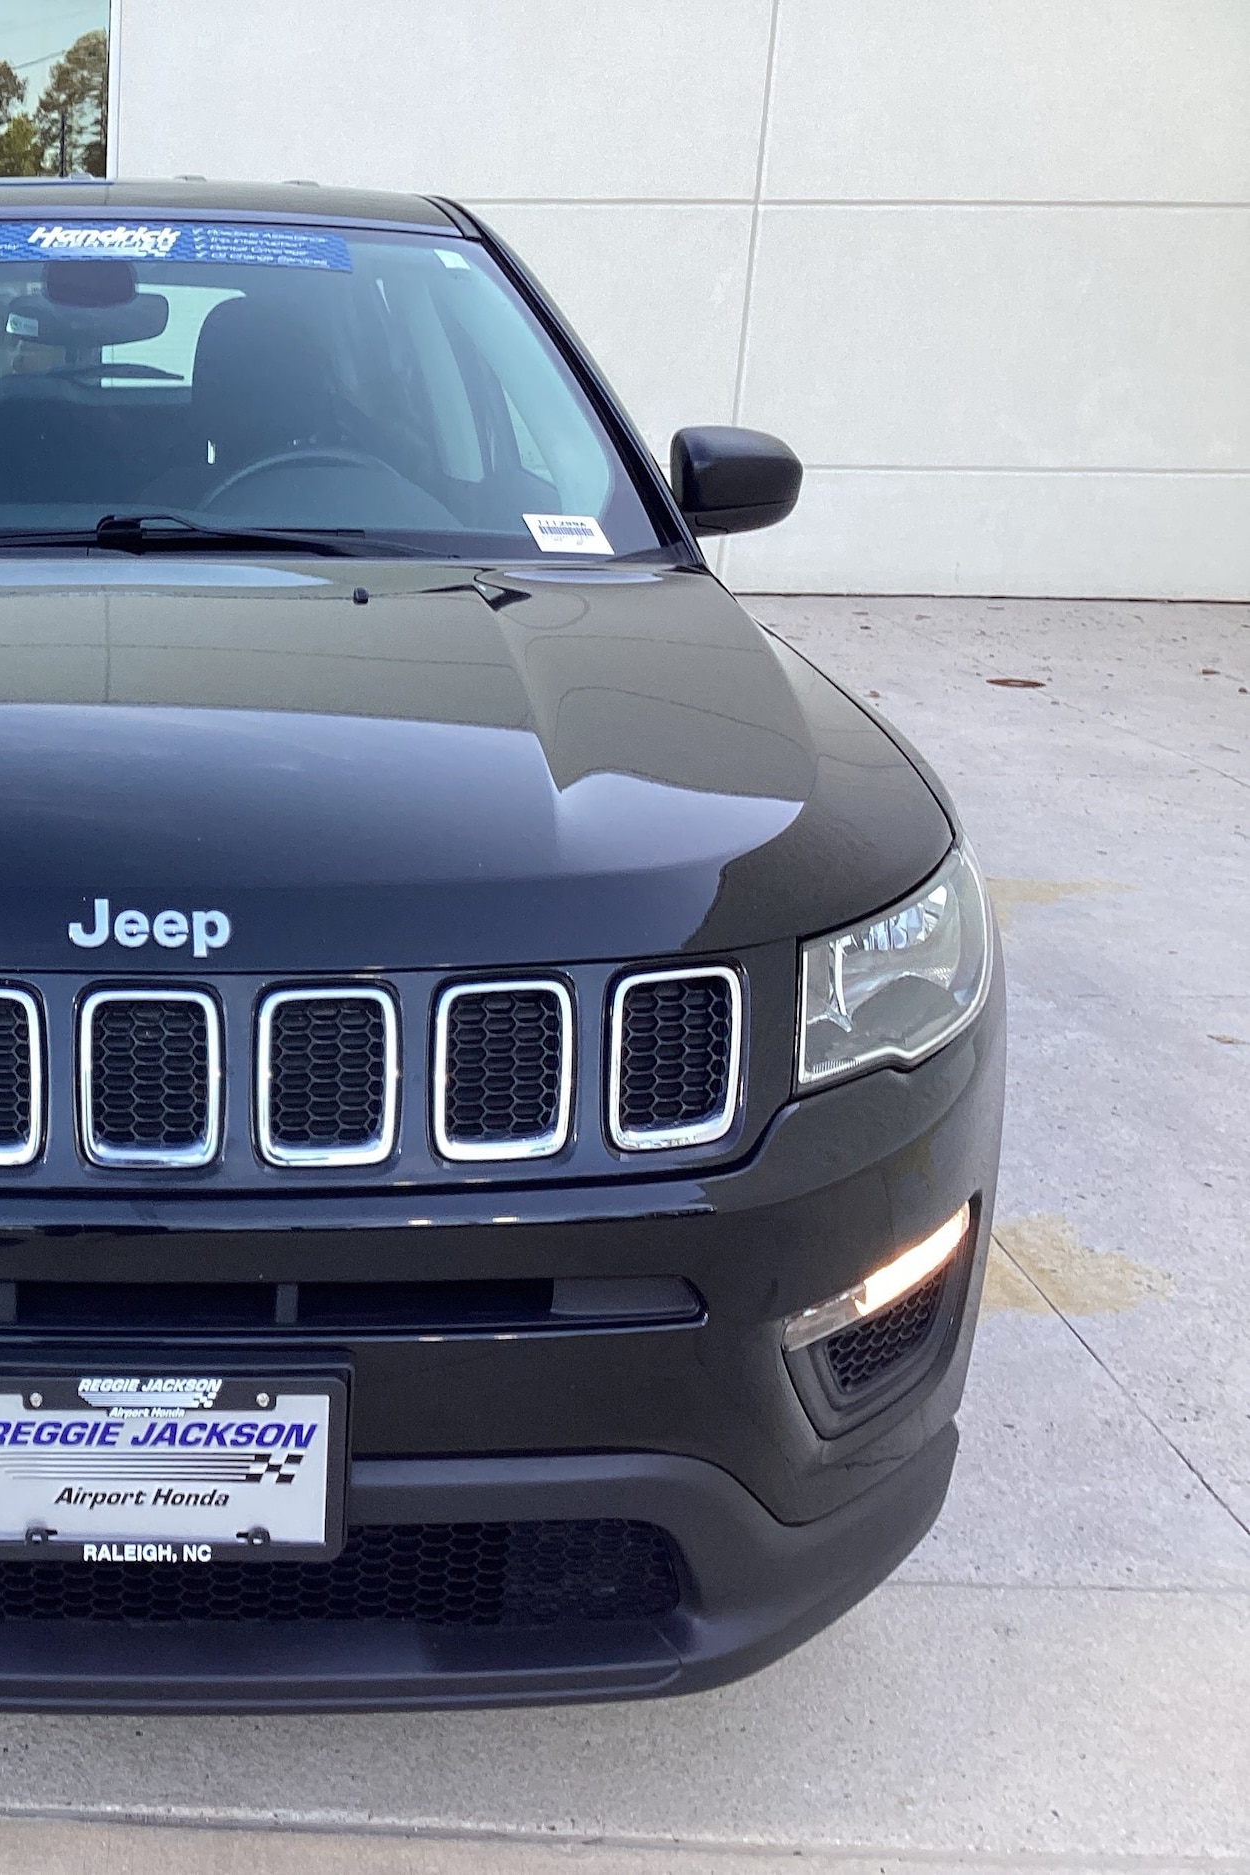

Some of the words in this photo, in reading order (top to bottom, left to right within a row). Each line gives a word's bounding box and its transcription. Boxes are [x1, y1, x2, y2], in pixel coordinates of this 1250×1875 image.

[68, 898, 230, 958] Jeep
[78, 1378, 140, 1392] REGGIE
[141, 1378, 223, 1393] JACKSON
[109, 1407, 150, 1419] Airport
[151, 1407, 185, 1418] Honda
[131, 1422, 318, 1449] JACKSON
[54, 1487, 146, 1510] Airport
[151, 1488, 229, 1507] Honda
[83, 1543, 178, 1563] RALEIGH,
[182, 1544, 212, 1562] NC
